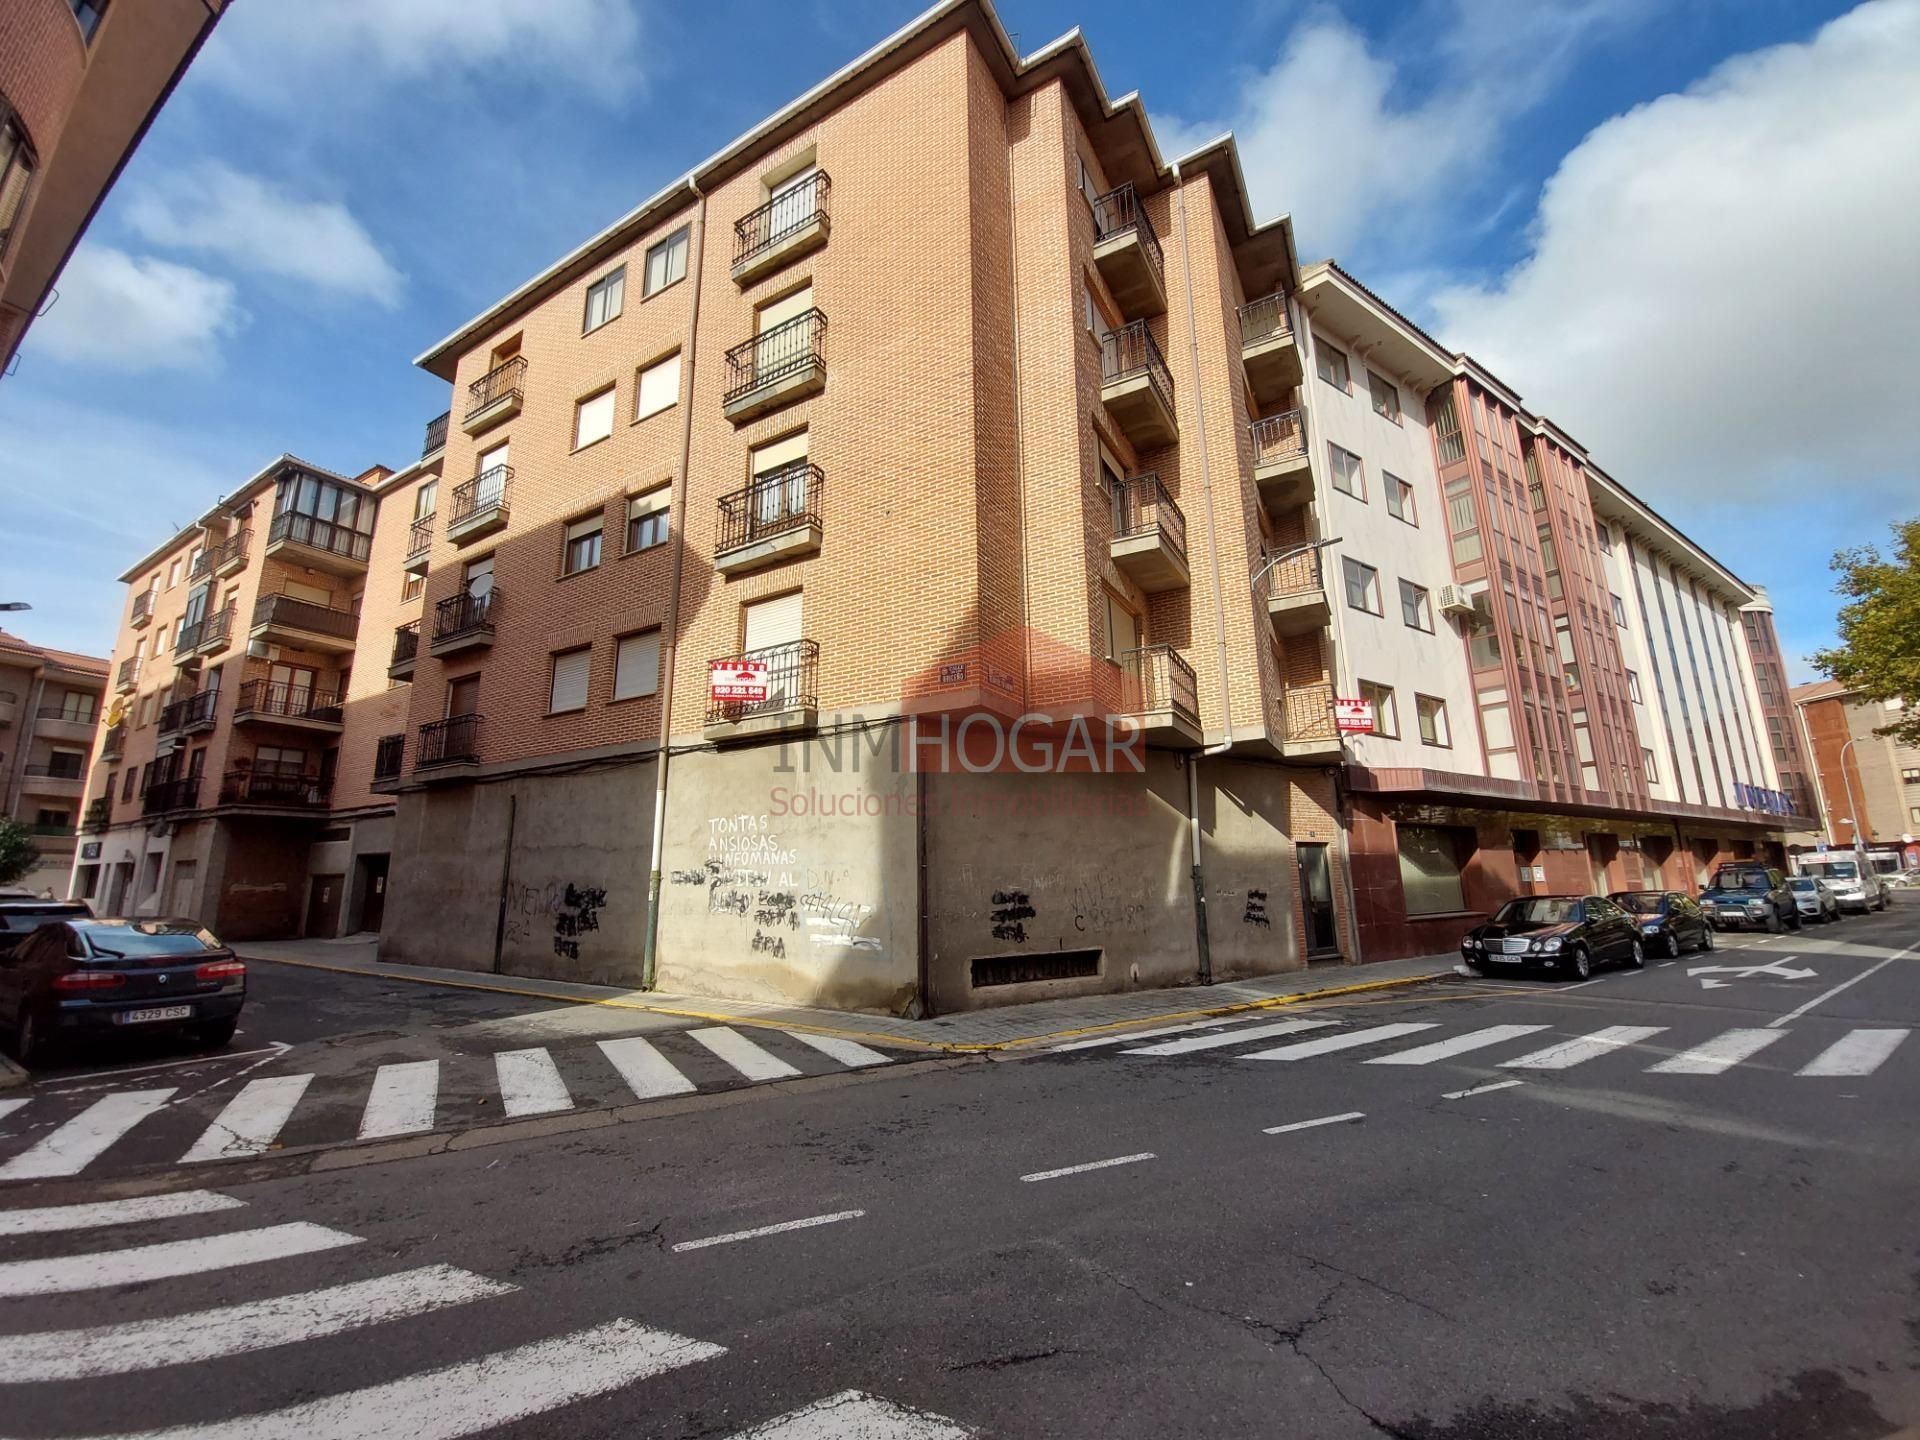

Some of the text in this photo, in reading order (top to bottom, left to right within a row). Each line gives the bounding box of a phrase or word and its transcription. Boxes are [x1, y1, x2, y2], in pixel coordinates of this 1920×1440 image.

[708, 815, 768, 834] TONTAS
[708, 835, 778, 851] ANSIOSAS
[778, 871, 798, 887] AL
[132, 1007, 187, 1021] 4329 CSC
